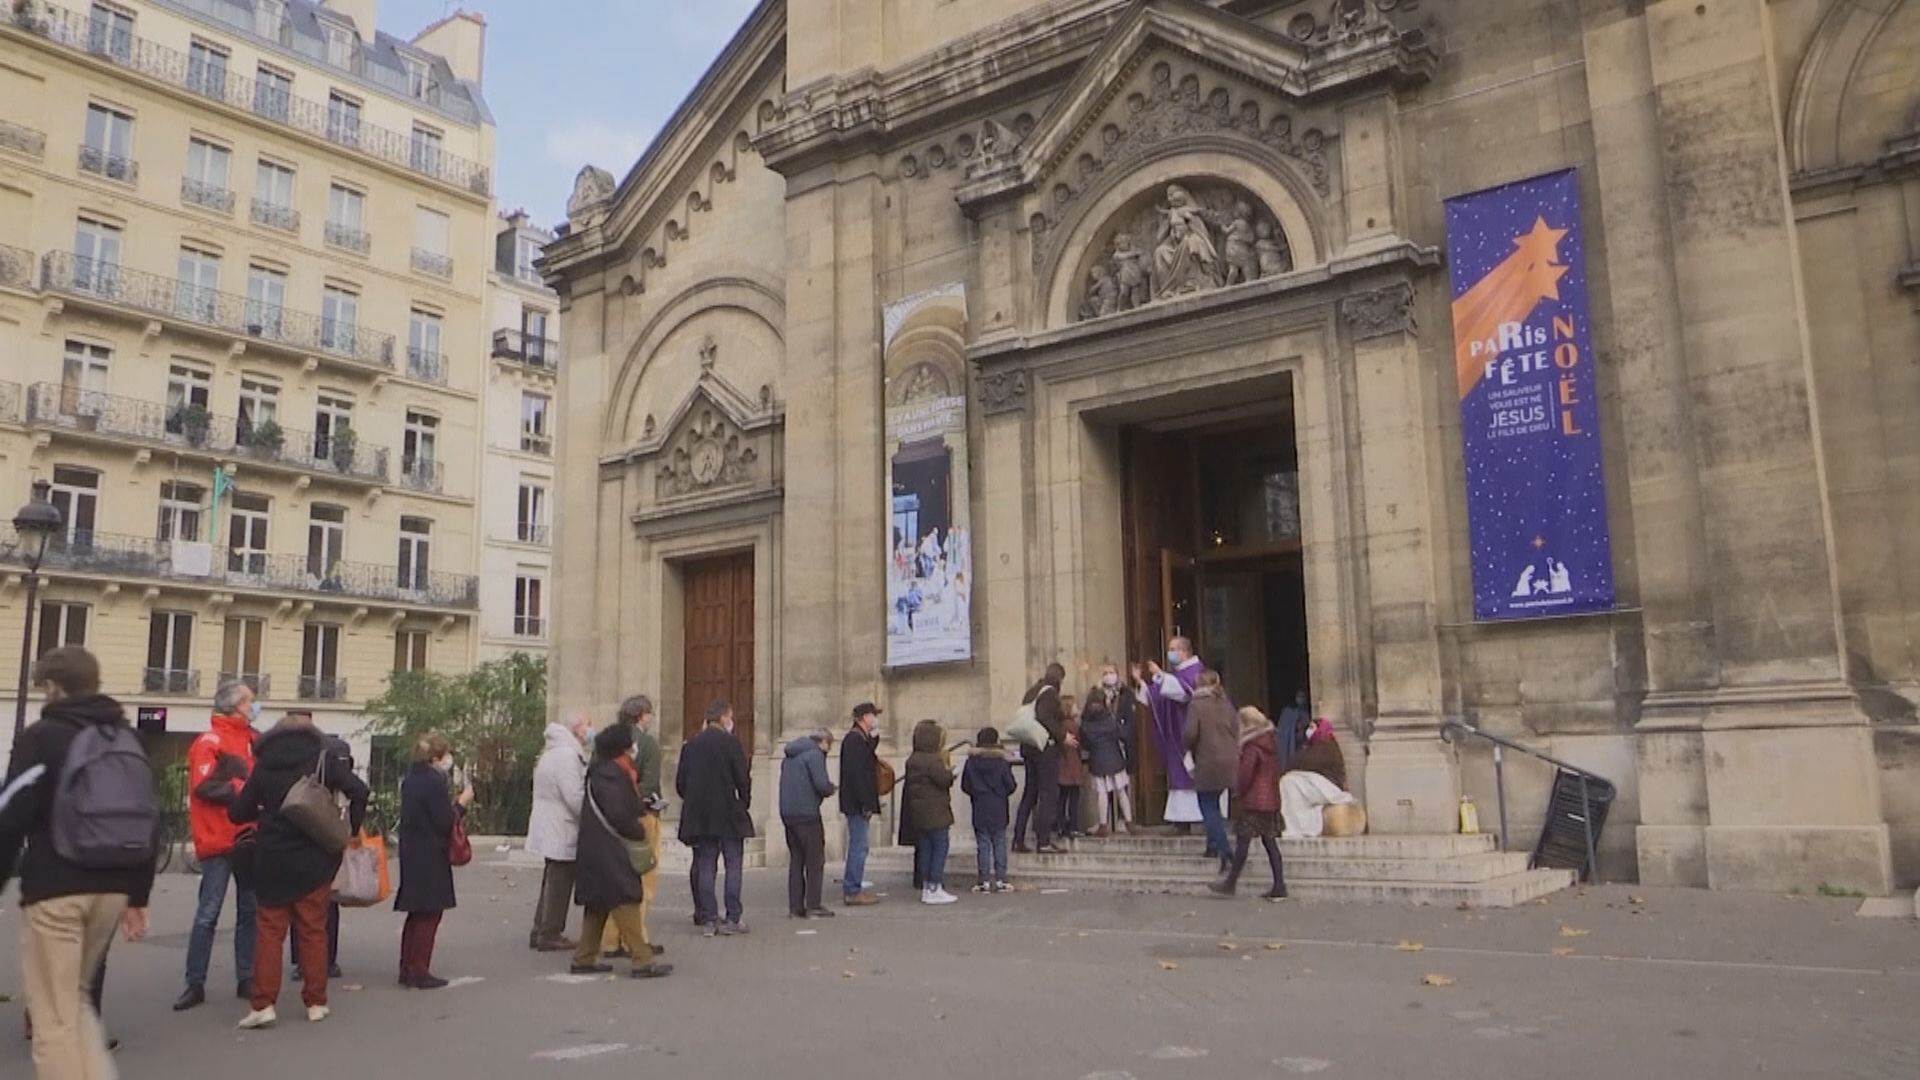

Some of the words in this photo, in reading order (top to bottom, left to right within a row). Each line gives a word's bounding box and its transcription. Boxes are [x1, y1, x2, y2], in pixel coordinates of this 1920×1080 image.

[1485, 350, 1550, 386] FÊTE
[1488, 405, 1545, 428] JÉSUS
[1529, 422, 1550, 433] DIEU
